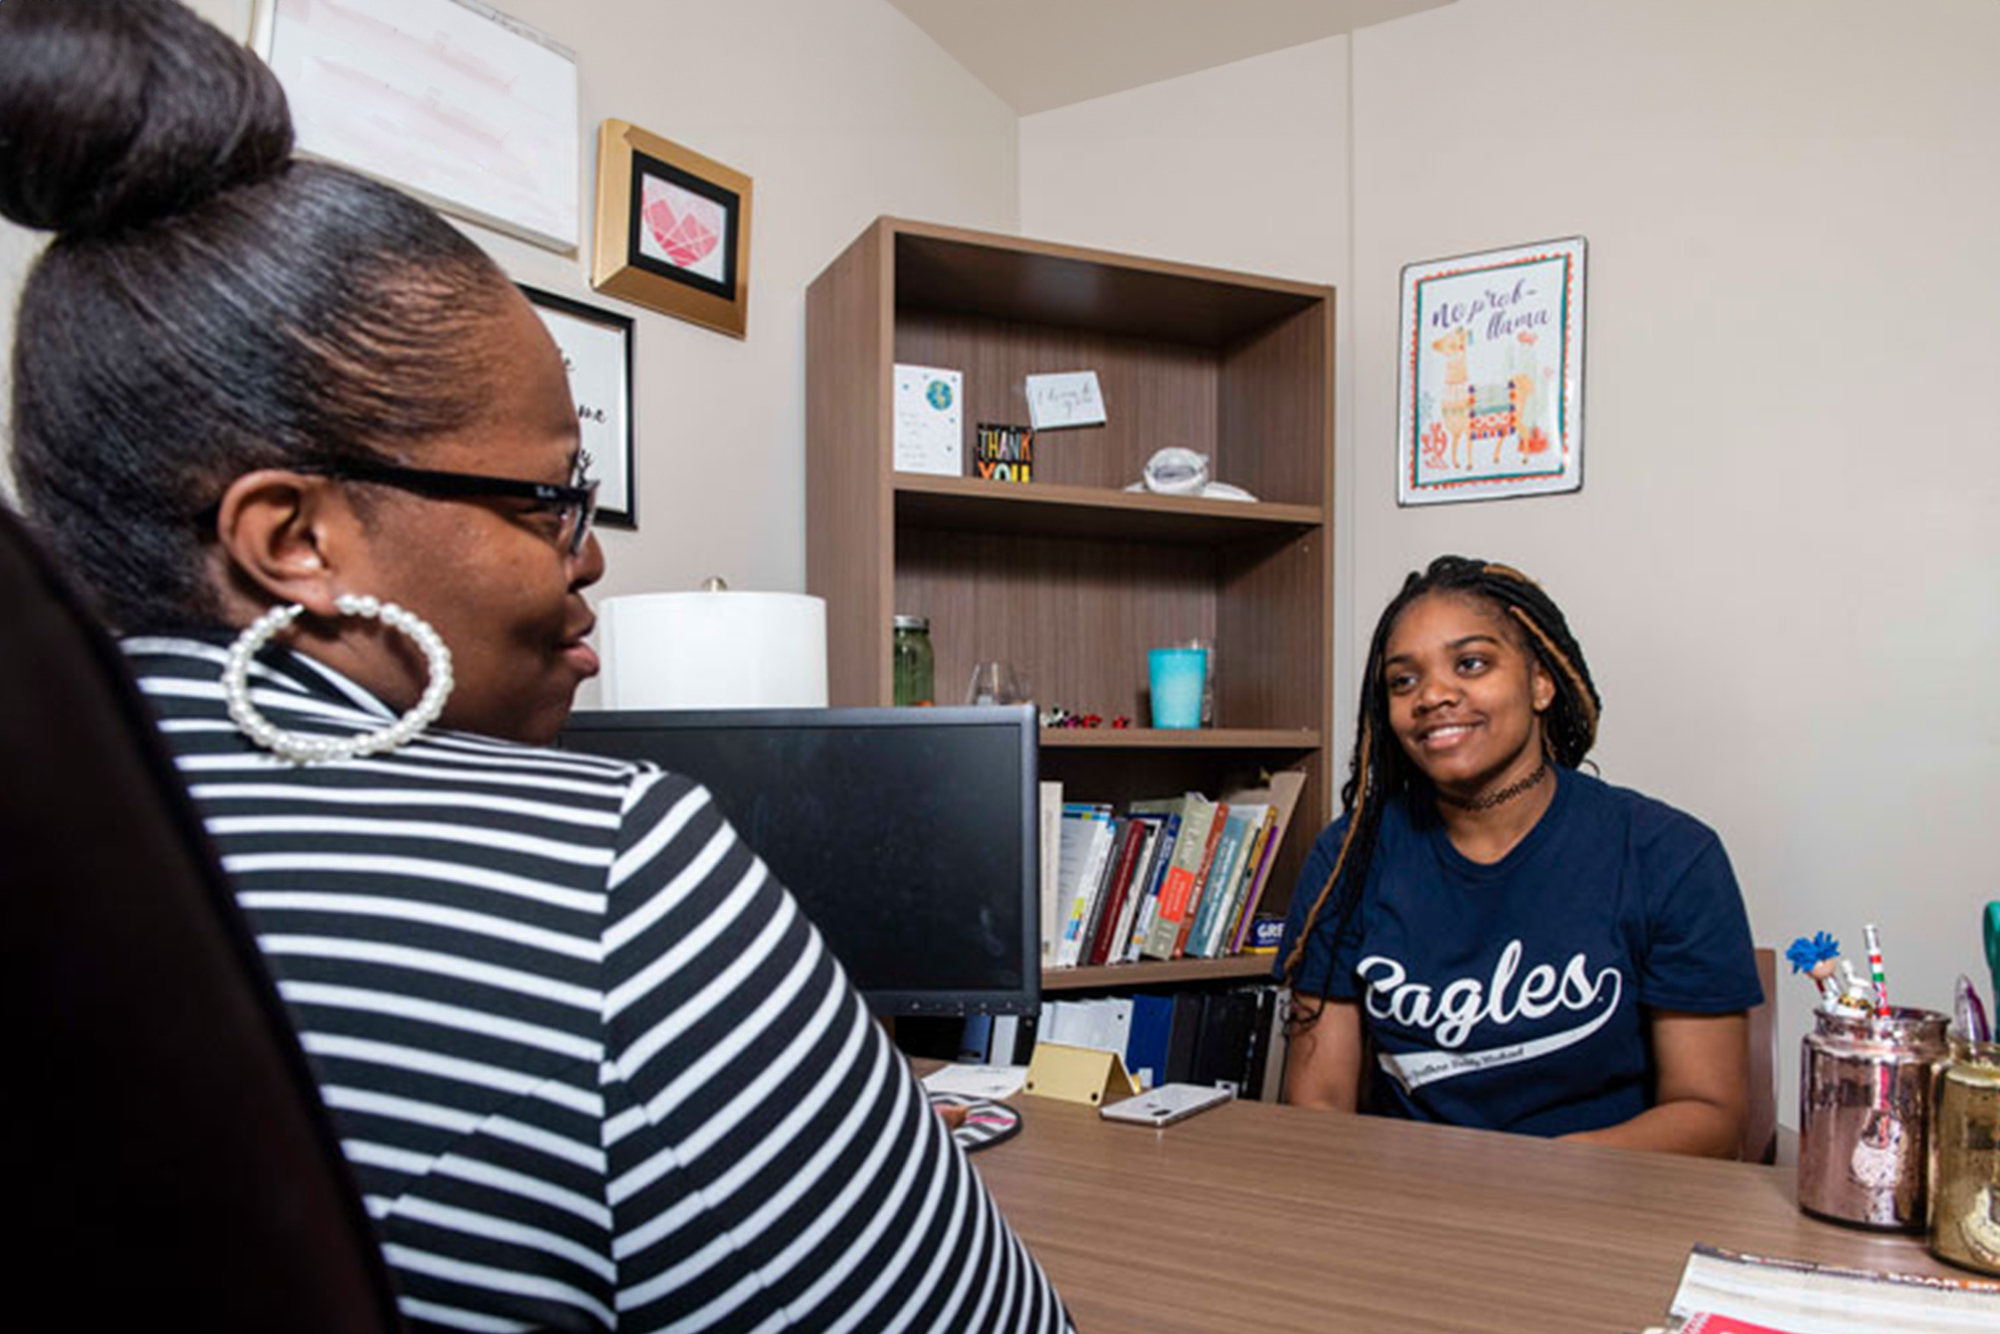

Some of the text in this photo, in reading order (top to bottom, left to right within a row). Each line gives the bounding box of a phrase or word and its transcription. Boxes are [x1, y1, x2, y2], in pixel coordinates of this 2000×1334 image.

[1486, 308, 1548, 340] llama
[979, 429, 1032, 461] THANK
[978, 461, 1030, 483] YOU
[1356, 939, 1606, 1048] Eagles
